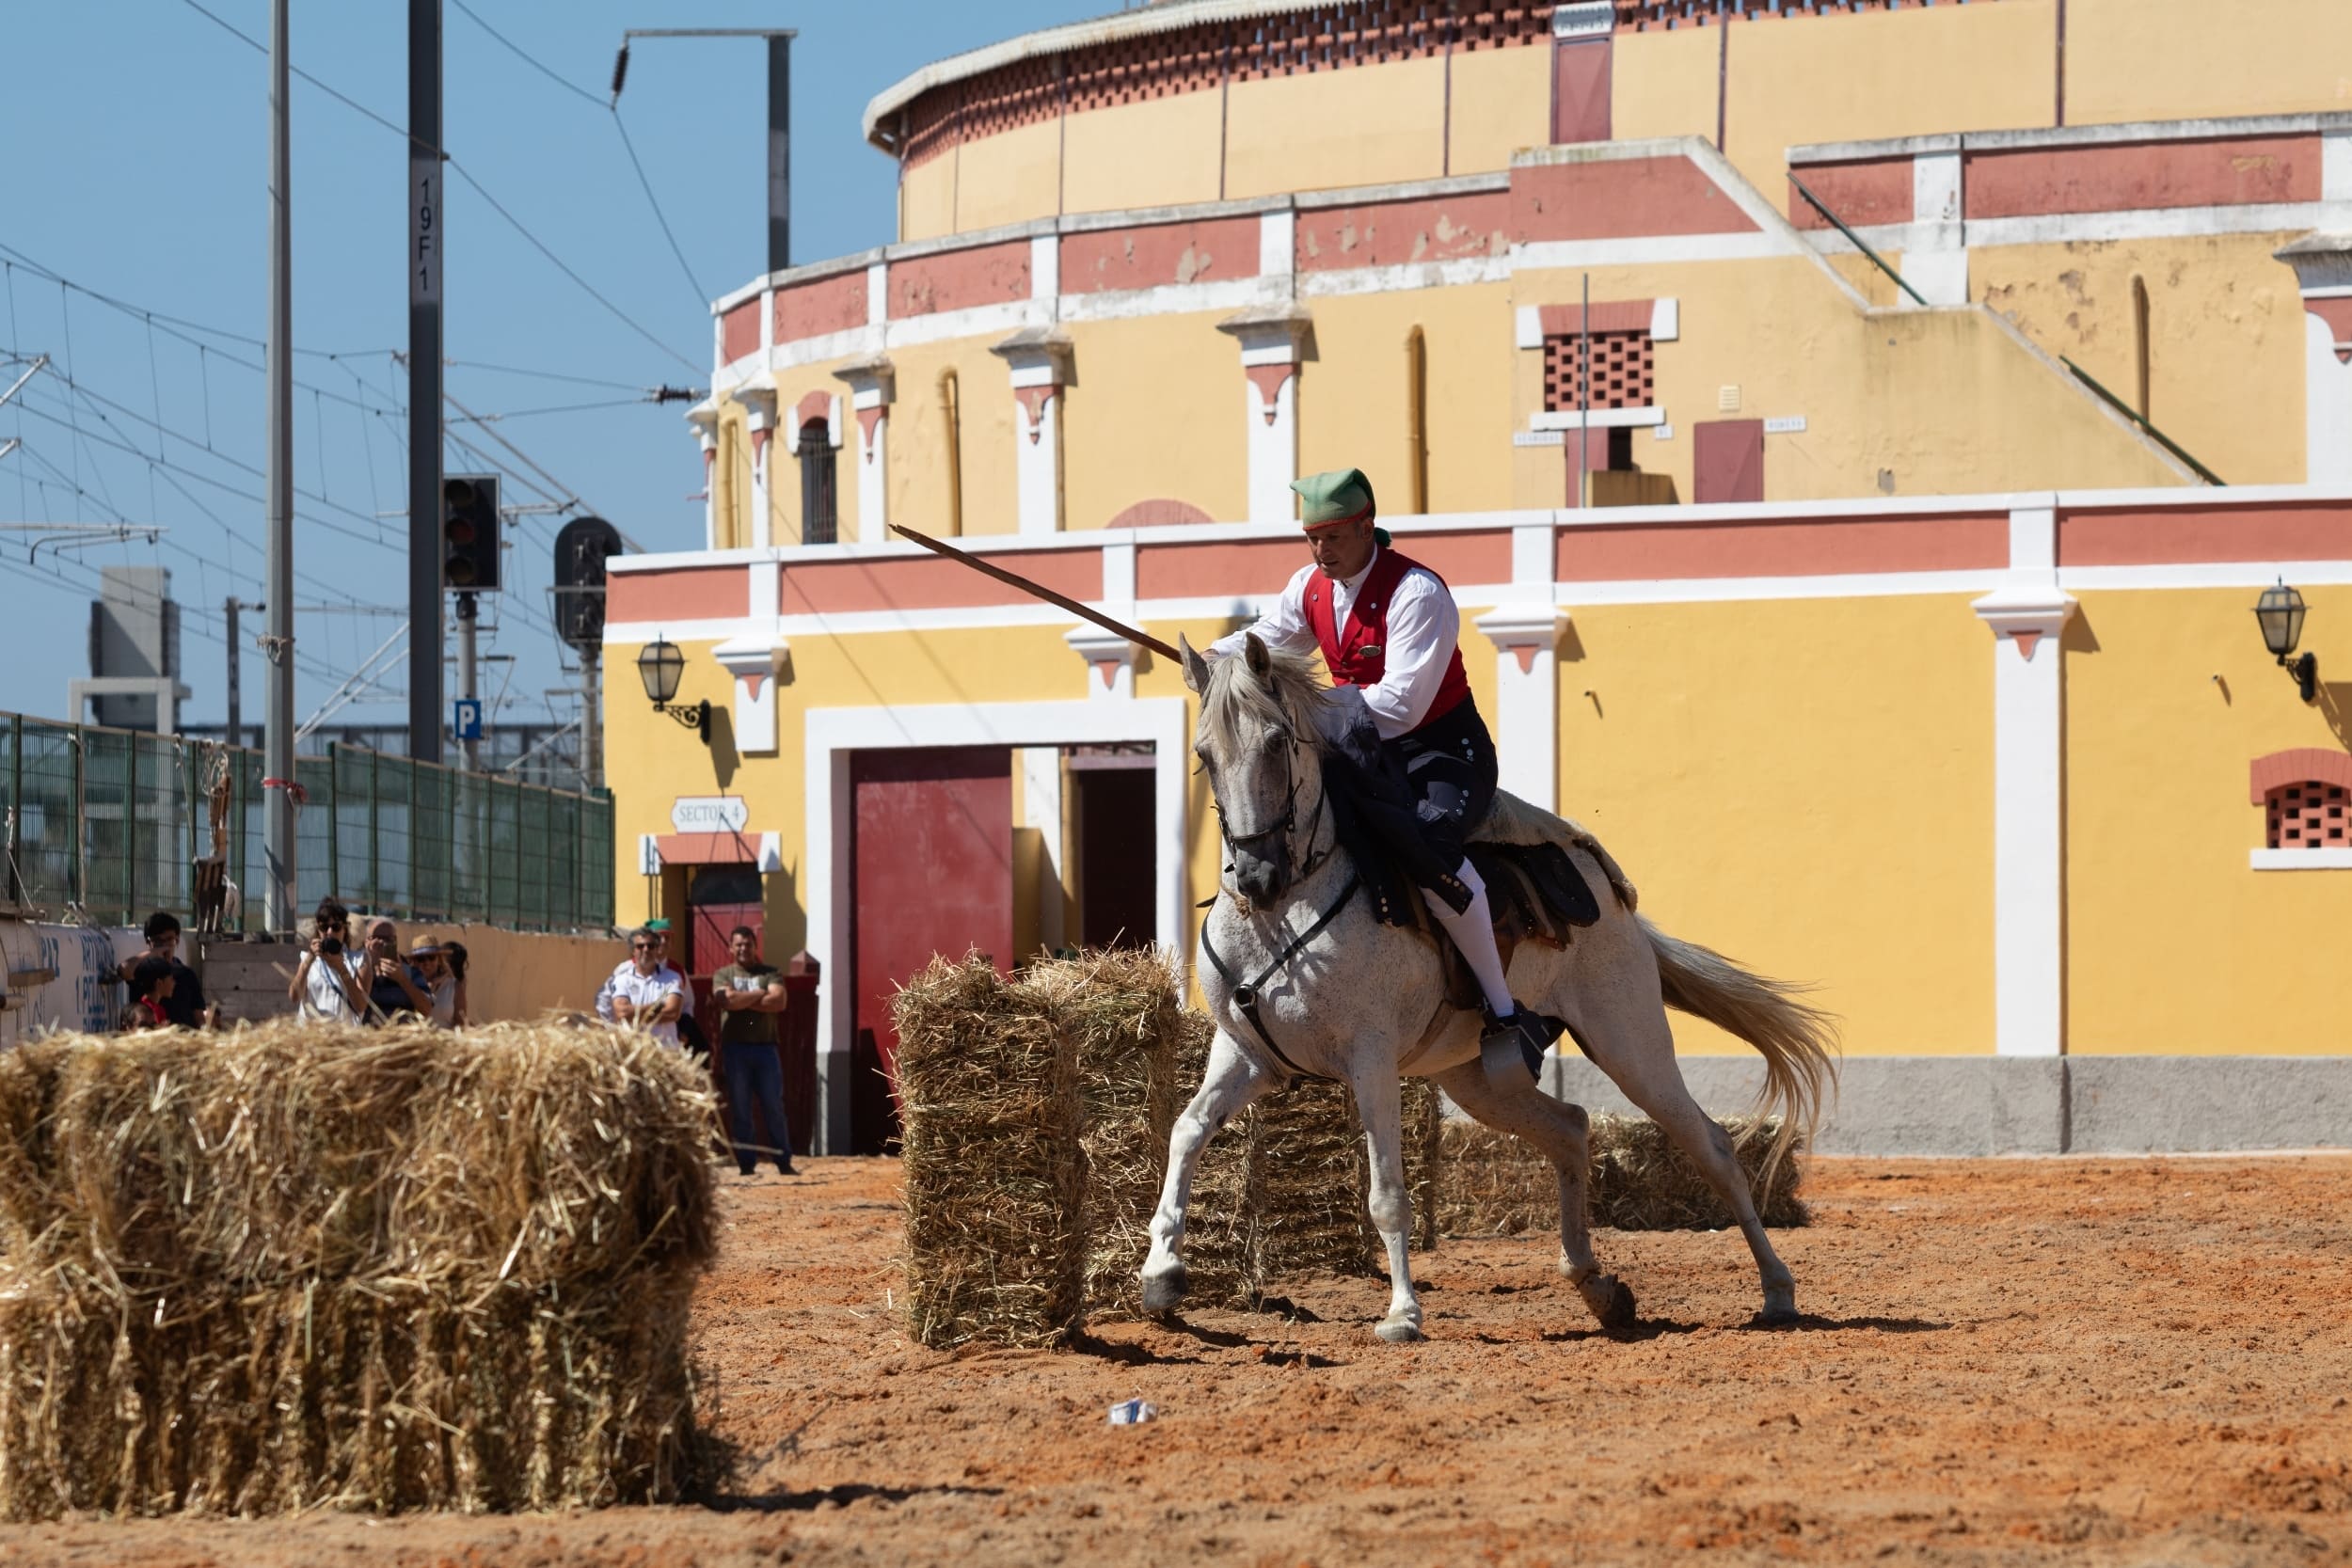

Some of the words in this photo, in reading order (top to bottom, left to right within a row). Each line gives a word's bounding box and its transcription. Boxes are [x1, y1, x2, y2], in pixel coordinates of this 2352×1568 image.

[419, 179, 431, 292] 19F1
[459, 705, 475, 735] P
[679, 804, 726, 822] SECTOR
[732, 805, 739, 821] 4
